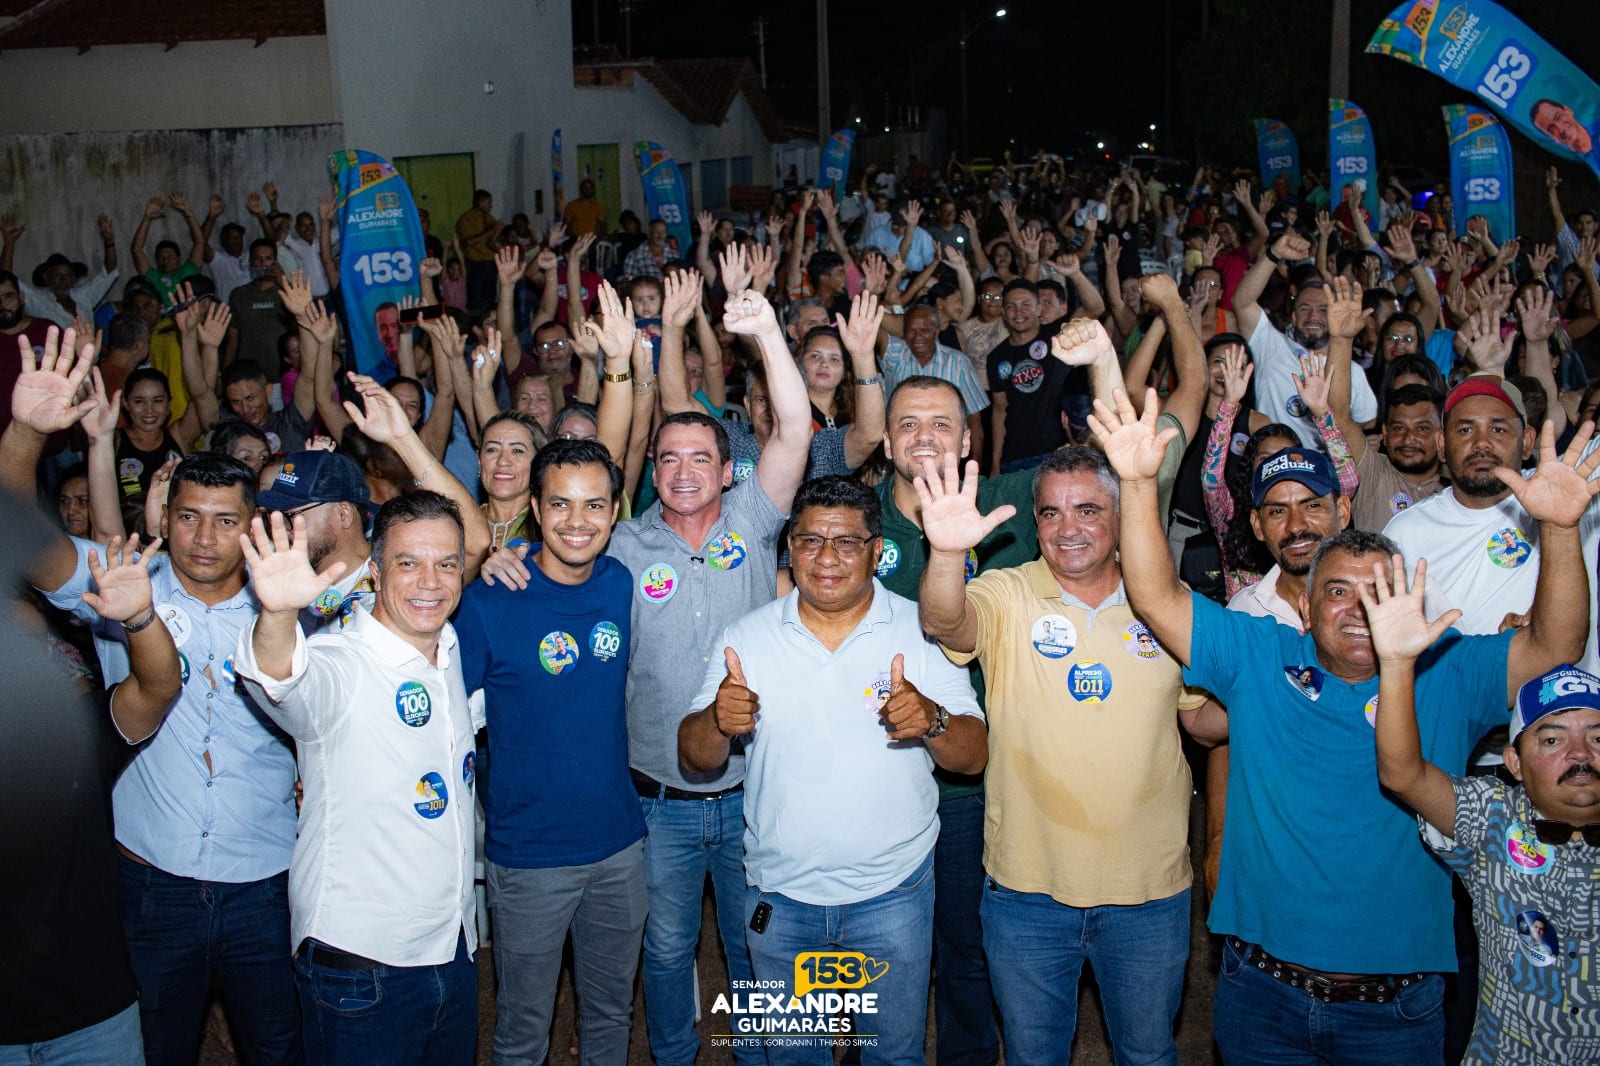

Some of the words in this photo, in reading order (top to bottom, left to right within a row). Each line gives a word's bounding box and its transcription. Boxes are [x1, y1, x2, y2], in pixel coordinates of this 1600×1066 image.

[1411, 7, 1433, 36] 153
[1438, 12, 1480, 74] ALEXANDRE
[1477, 45, 1531, 109] 153
[1267, 155, 1293, 169] 153
[1336, 156, 1368, 174] 153
[361, 169, 381, 187] 153
[347, 208, 404, 224] ALEXANDRE
[354, 251, 413, 285] 153
[652, 579, 667, 590] 45
[593, 632, 620, 653] 100
[1074, 679, 1103, 694] 1011
[400, 692, 429, 716] 100
[429, 798, 445, 811] 1011
[1519, 842, 1537, 859] 45
